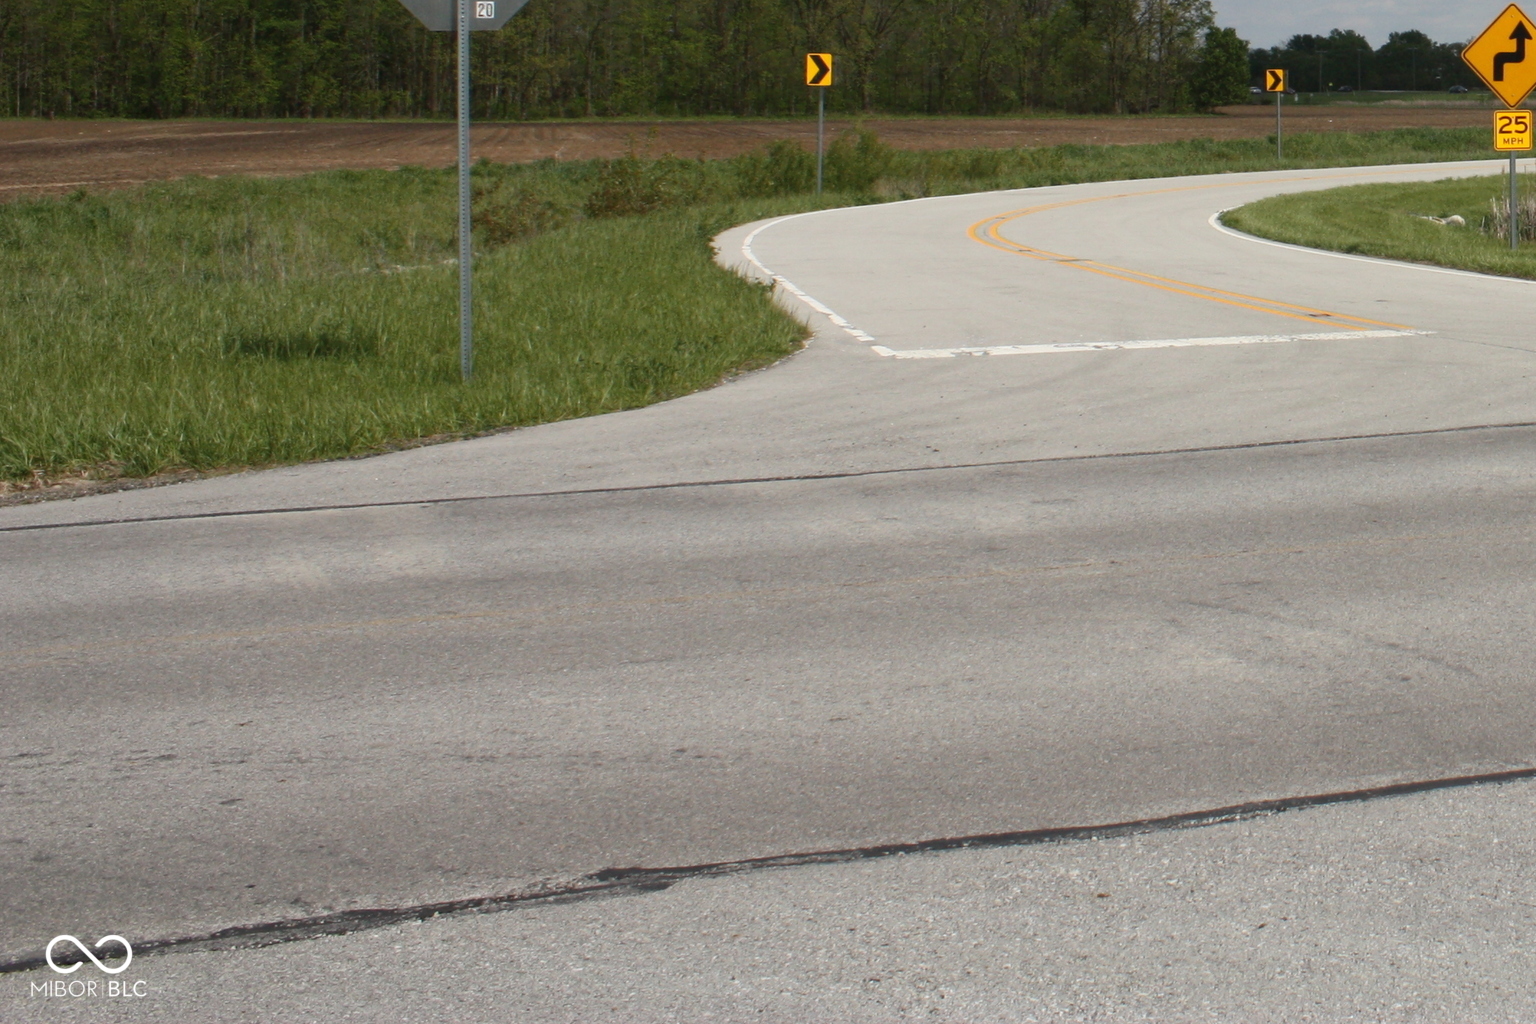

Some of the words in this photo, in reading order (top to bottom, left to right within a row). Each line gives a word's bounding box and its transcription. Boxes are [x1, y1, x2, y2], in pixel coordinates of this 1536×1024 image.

[478, 3, 493, 17] 20
[1498, 116, 1528, 134] 25
[1503, 137, 1524, 145] MPH
